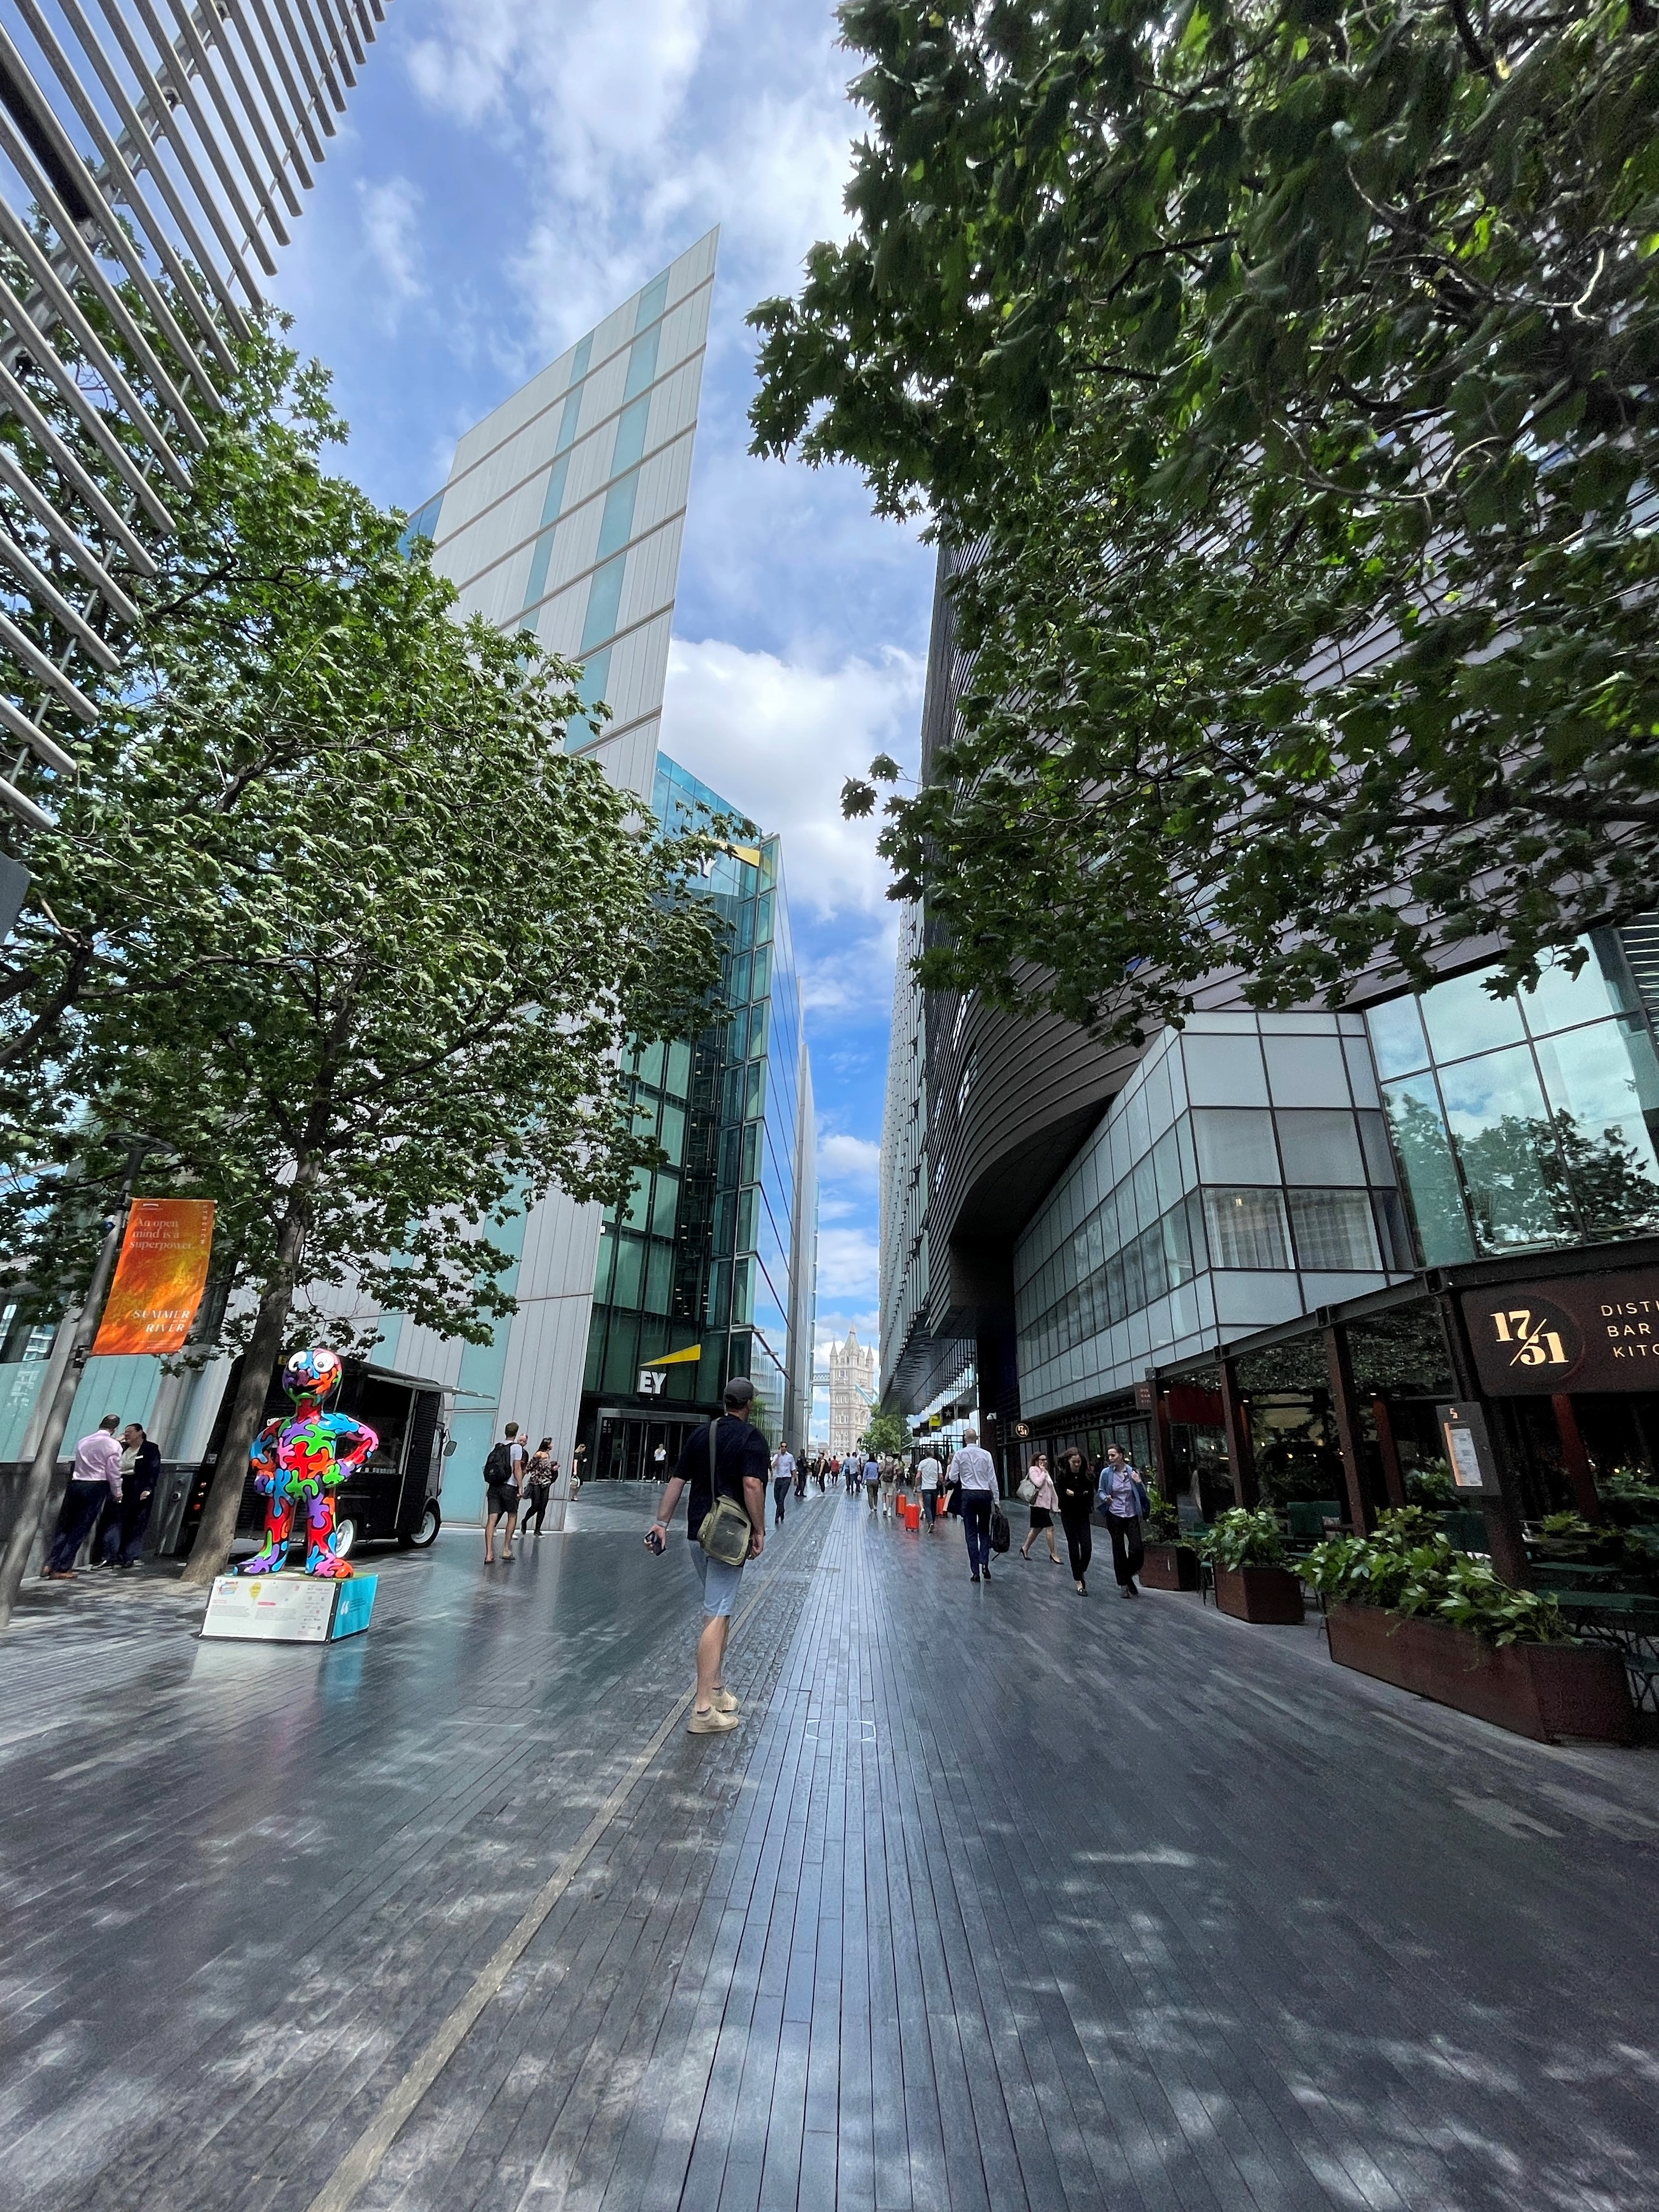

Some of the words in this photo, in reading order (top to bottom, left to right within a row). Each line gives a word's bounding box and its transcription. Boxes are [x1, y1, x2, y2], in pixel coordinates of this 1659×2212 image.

[138, 1218, 151, 1227] An
[153, 1220, 178, 1229] open
[133, 1229, 160, 1238] mind
[163, 1230, 170, 1239] is
[133, 1310, 190, 1318] SUMMER
[146, 1324, 185, 1332] RIVER
[1607, 1323, 1651, 1337] BAR
[637, 1370, 666, 1394] EY
